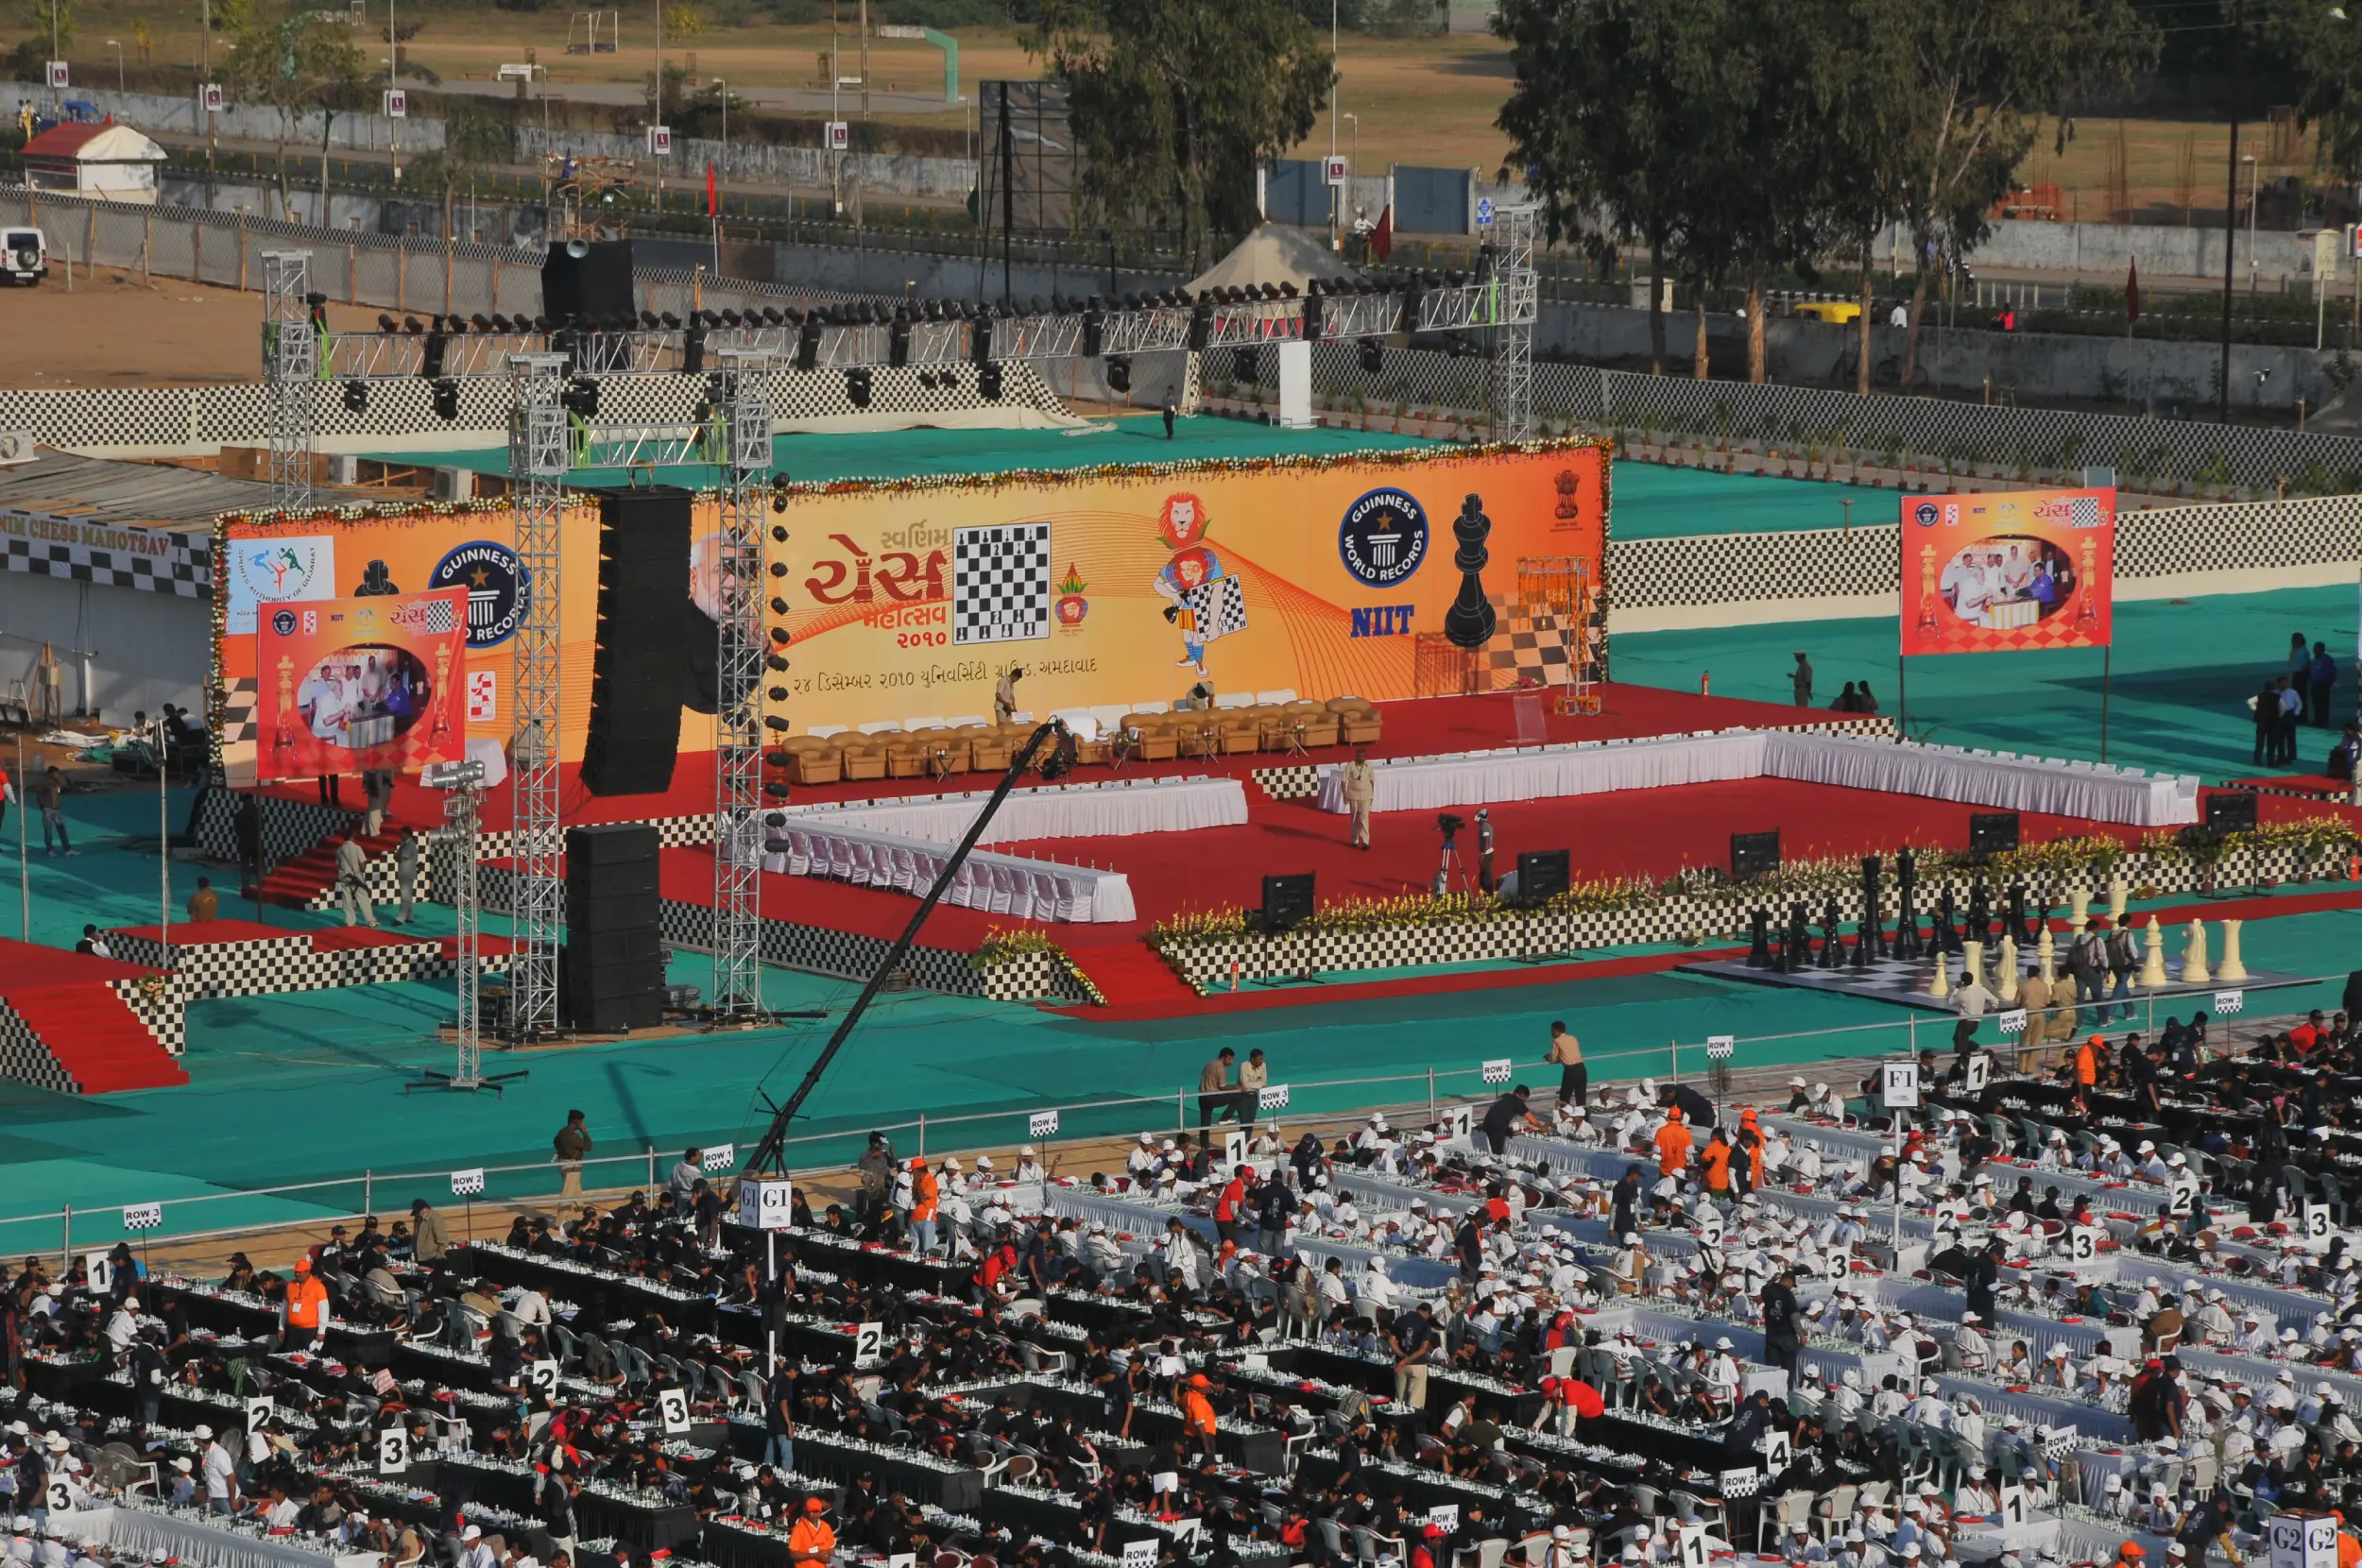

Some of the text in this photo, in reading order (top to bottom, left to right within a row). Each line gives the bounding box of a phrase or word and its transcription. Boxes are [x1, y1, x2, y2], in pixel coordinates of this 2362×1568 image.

[1351, 494, 1417, 523] GUINNESS
[28, 519, 78, 543] CHESS
[82, 525, 170, 556] MAHOTSAV
[881, 519, 949, 550] સ્વર્ણિમ
[441, 548, 517, 579] GUINNESS
[1344, 530, 1423, 581] WORLD RECORDS
[804, 534, 948, 605] ચેસ
[1350, 605, 1414, 638] NIIT
[897, 631, 947, 649] ૨૦૧૦
[794, 678, 812, 694] ૨૪
[879, 672, 915, 689] ૨૦૧૦
[1039, 658, 1098, 674] અમદાવાદ
[2217, 997, 2235, 1006] ROW
[2001, 1016, 2019, 1025] ROW
[1483, 1065, 1502, 1074] ROW
[1889, 1070, 1914, 1087] F1
[1973, 1063, 1984, 1083] 1
[1260, 1093, 1281, 1101] ROW
[1031, 1118, 1050, 1128] ROW
[1457, 1114, 1467, 1134] 1
[705, 1152, 726, 1162] ROW
[1230, 1139, 1241, 1162] 1
[453, 1174, 482, 1185] ROW 2
[742, 1187, 757, 1208] G1
[762, 1189, 789, 1208] G1
[2172, 1186, 2190, 1210] 2
[125, 1210, 150, 1220] ROW
[1936, 1210, 1955, 1234] 2
[2312, 1211, 2327, 1236] 3
[2076, 1234, 2092, 1259] 3
[93, 1260, 105, 1285] 1
[1831, 1254, 1846, 1279] 3
[859, 1330, 879, 1356] 2
[536, 1368, 555, 1394] 2
[251, 1405, 271, 1433] 2
[665, 1397, 686, 1424] 3
[384, 1437, 403, 1465] 3
[1770, 1440, 1789, 1468] 4
[2047, 1435, 2068, 1448] ROW
[1725, 1474, 1755, 1487] ROW 2
[49, 1482, 72, 1511] 3
[2008, 1494, 2021, 1523] 1
[1430, 1512, 1457, 1523] ROW 3
[1178, 1526, 1195, 1549] 4
[2273, 1526, 2302, 1553] G2
[2308, 1527, 2336, 1552] G2
[1125, 1548, 1157, 1560] ROW 4
[1687, 1536, 1703, 1565] 1
